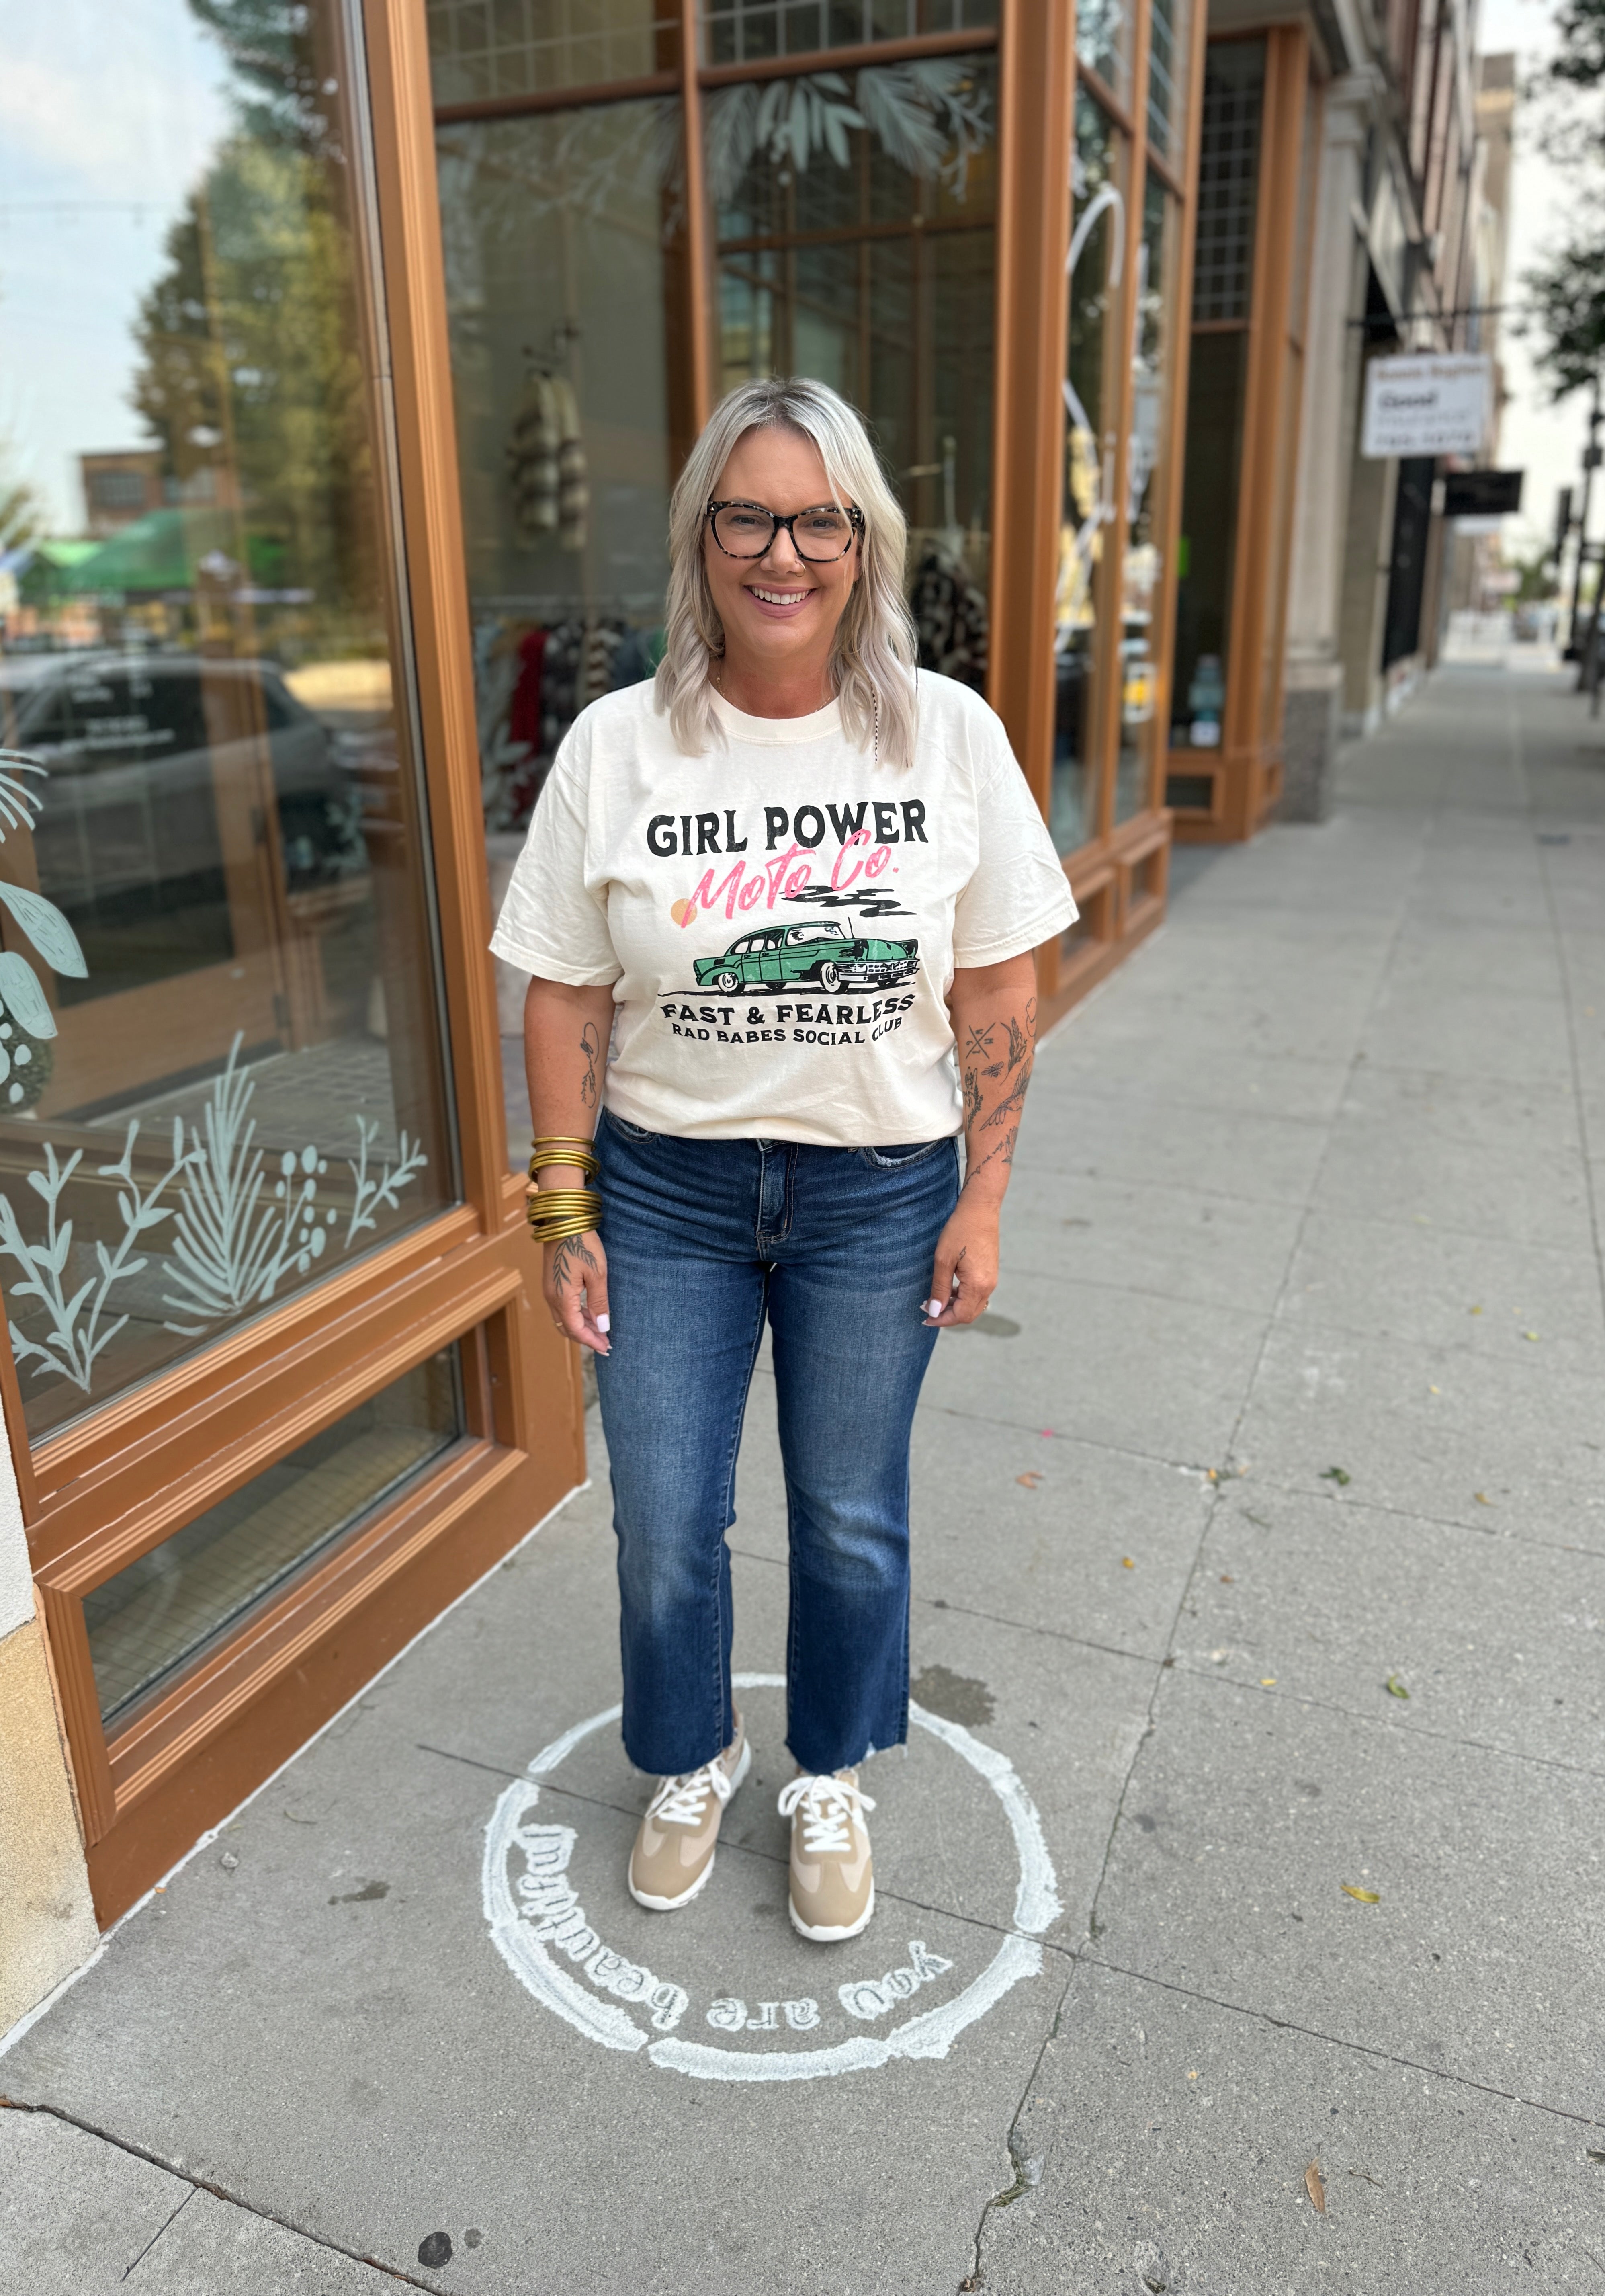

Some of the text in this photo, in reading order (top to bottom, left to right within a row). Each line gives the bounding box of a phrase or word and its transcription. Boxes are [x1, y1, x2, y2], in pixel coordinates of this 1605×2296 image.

[647, 800, 928, 857] GIRL POWER
[831, 829, 899, 891] Co.
[660, 994, 915, 1025] FAST & FEARLESS
[672, 1017, 901, 1045] RAD BABES SOCIAL CLUB
[515, 1825, 690, 2030] beautiful
[707, 1998, 821, 2031] are
